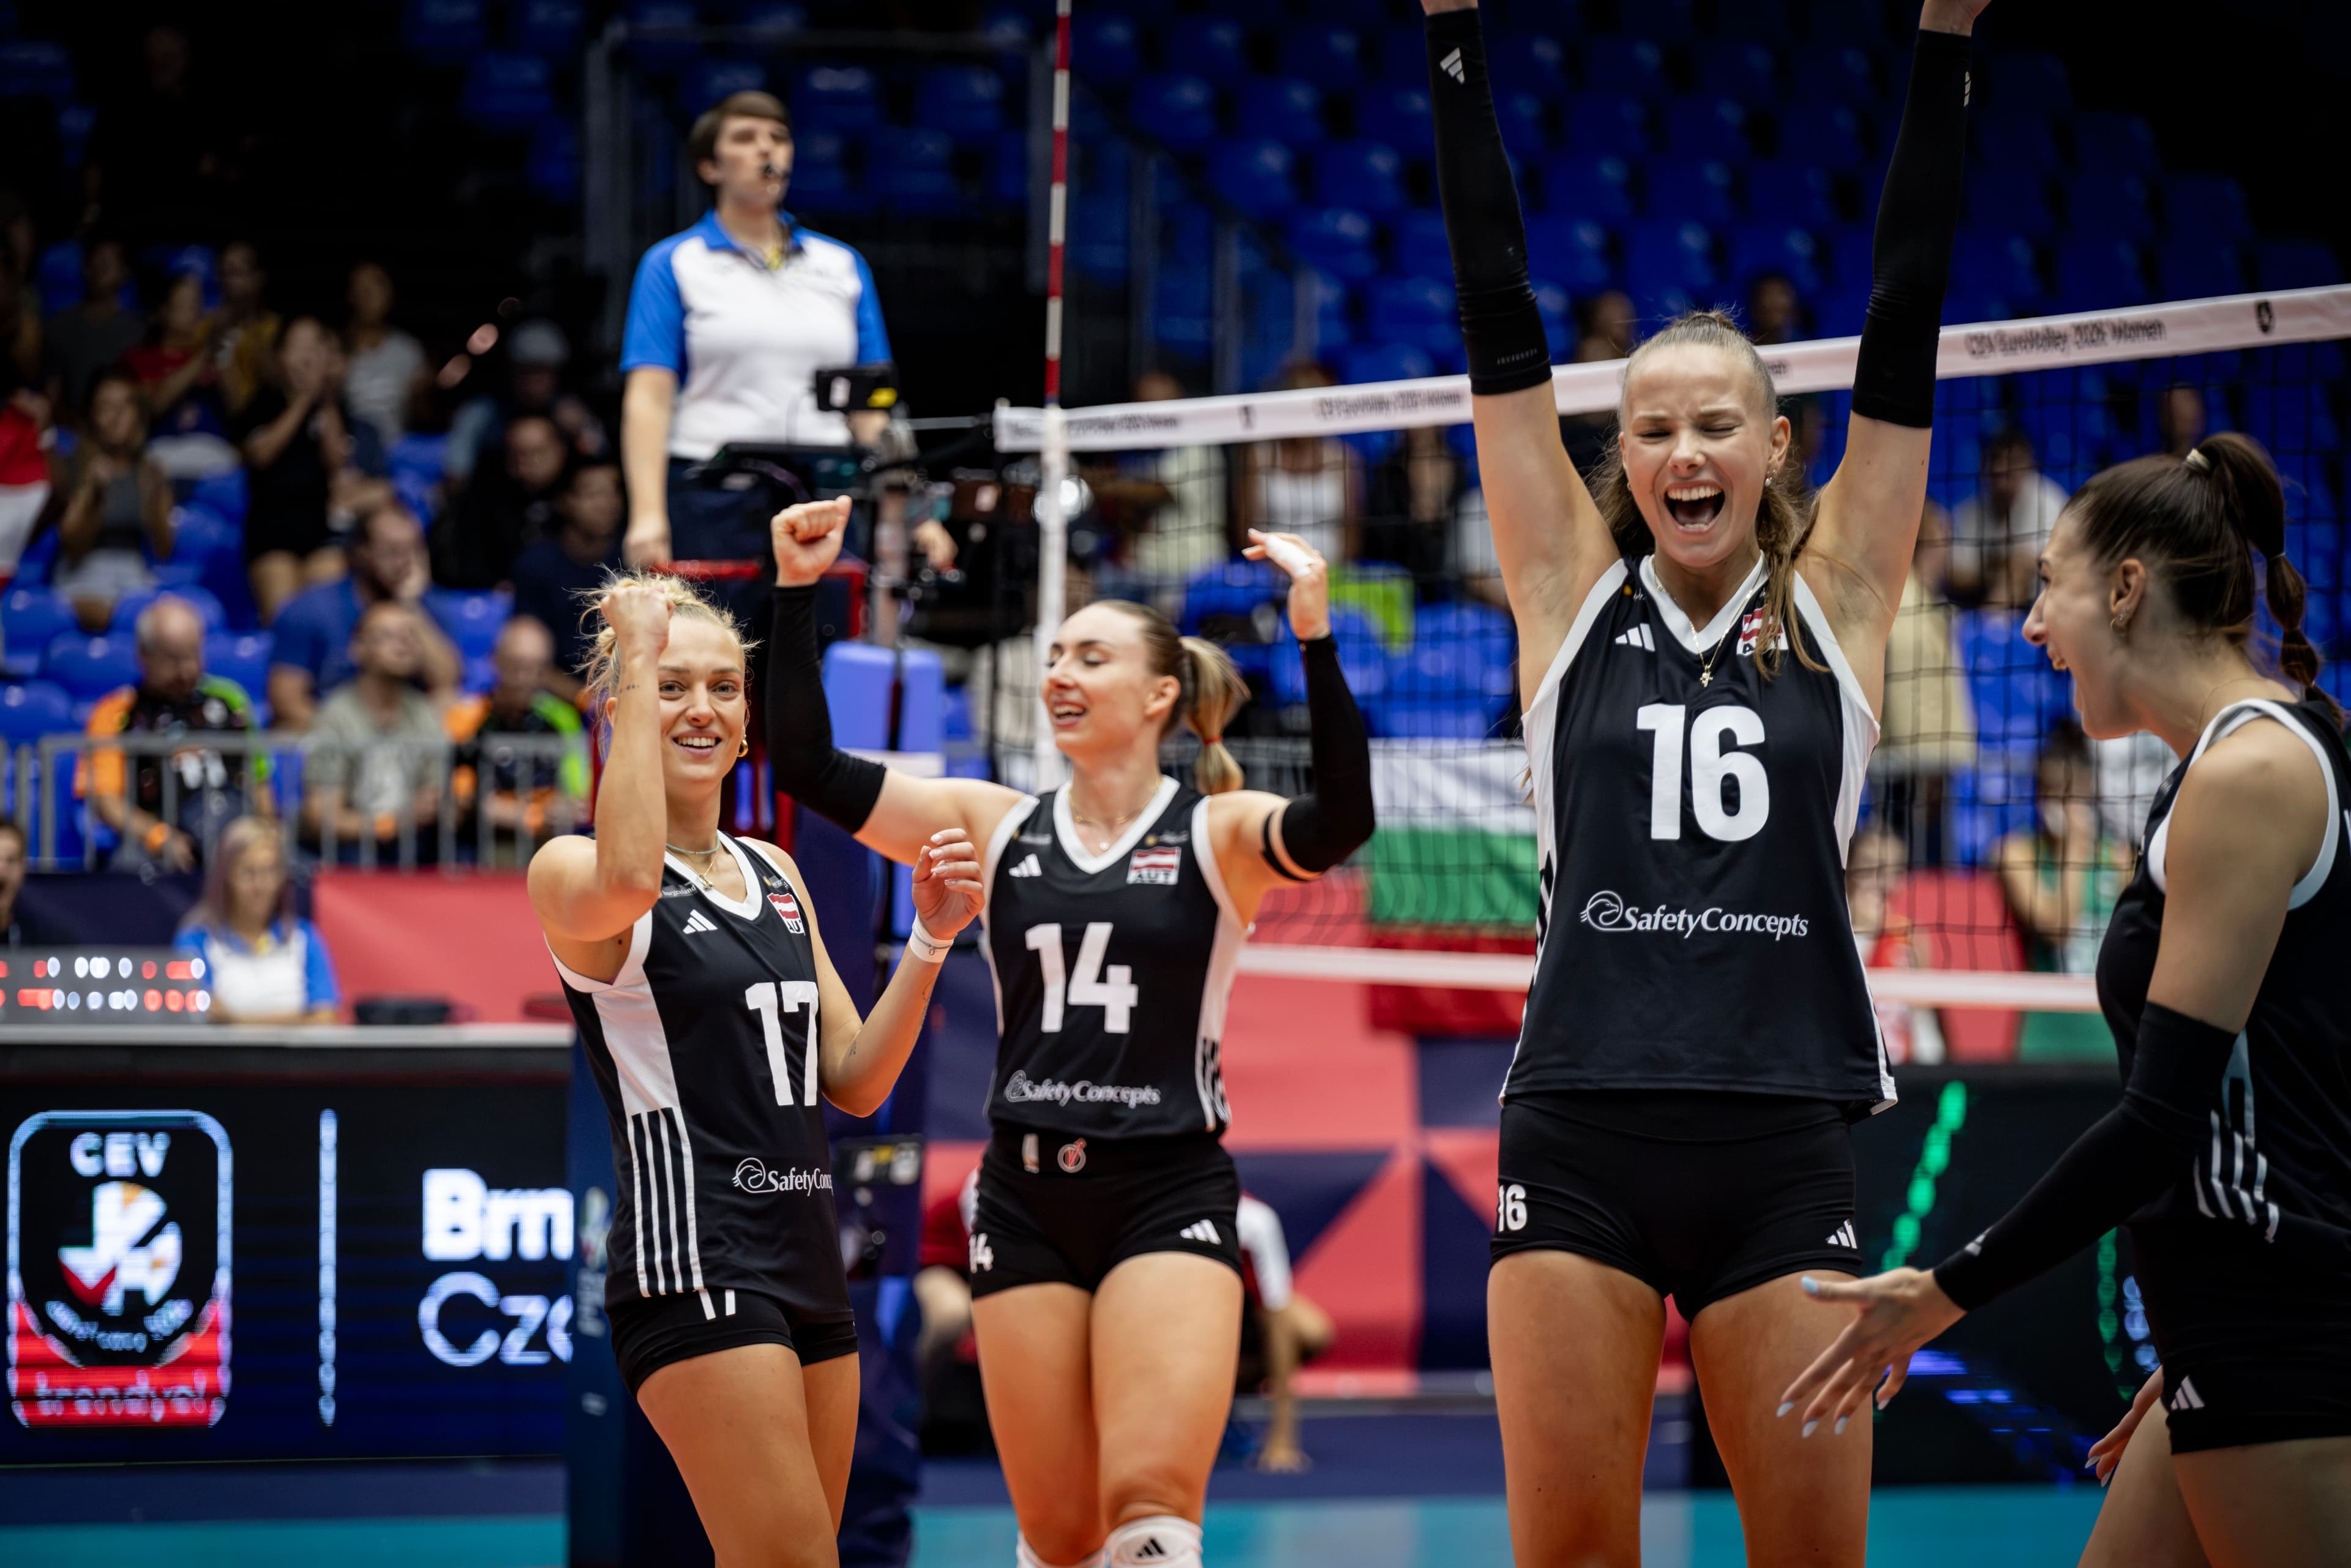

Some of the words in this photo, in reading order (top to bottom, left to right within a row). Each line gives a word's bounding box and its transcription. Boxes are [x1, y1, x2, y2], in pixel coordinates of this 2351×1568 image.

[1637, 704, 1771, 842] 16
[786, 919, 801, 932] AU
[1624, 904, 1809, 940] SafetyConcepts
[1025, 922, 1138, 1033] 14
[745, 980, 819, 1106] 17
[1021, 1078, 1161, 1109] SafetyConcepts
[70, 1132, 171, 1177] CEV
[1498, 1184, 1528, 1232] 16
[969, 1232, 994, 1274] 14
